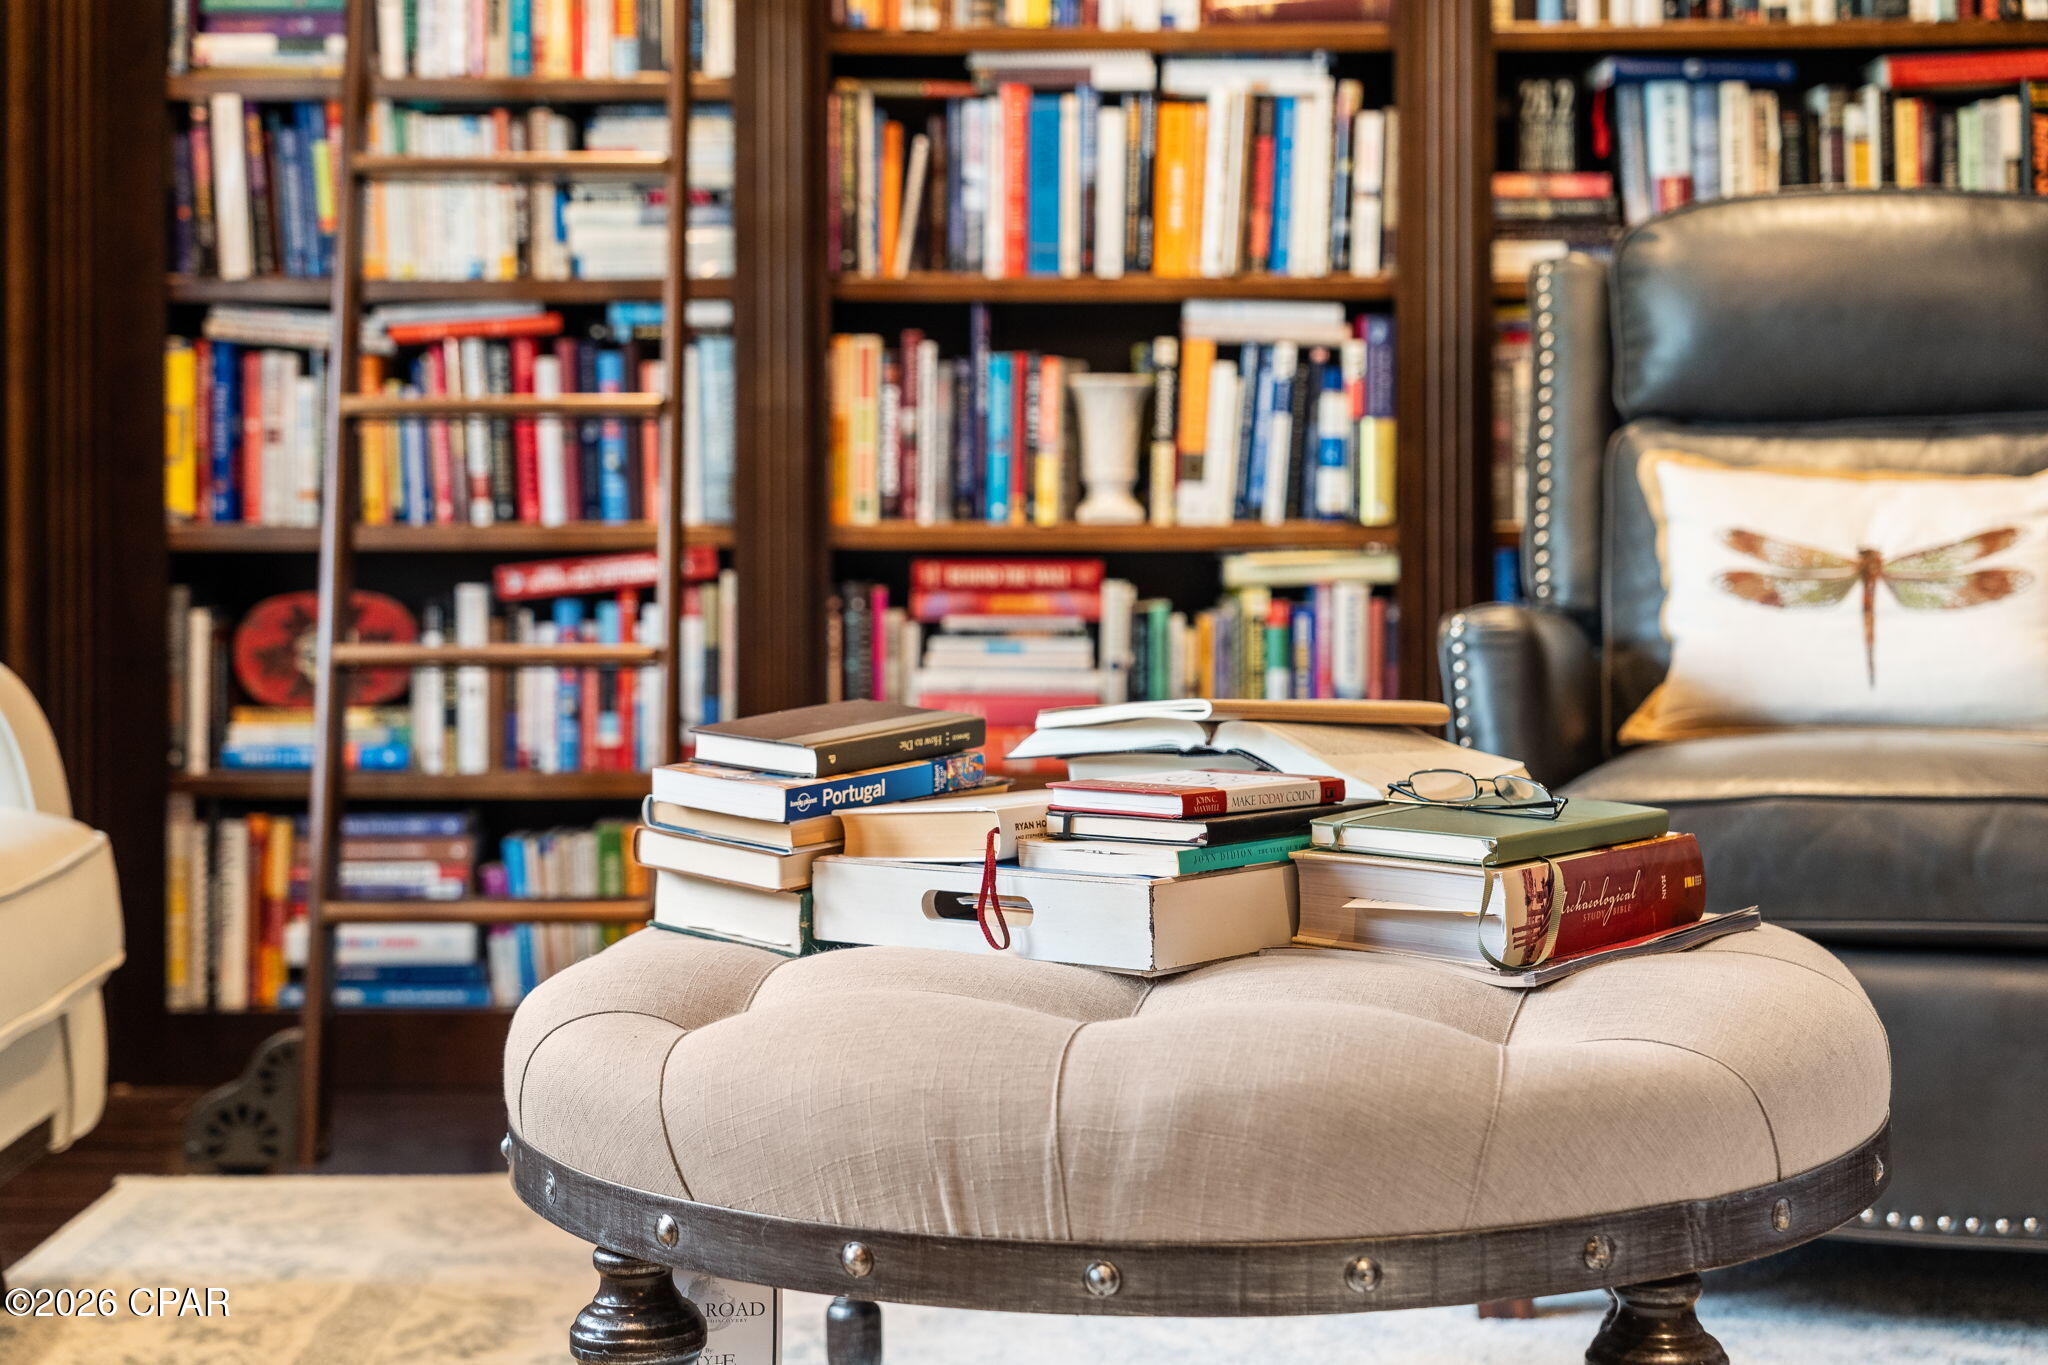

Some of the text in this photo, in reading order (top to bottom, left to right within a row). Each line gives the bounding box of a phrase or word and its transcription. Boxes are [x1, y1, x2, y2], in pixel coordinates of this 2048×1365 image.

[822, 778, 886, 807] Portugal
[1196, 795, 1211, 806] JOHN
[1231, 788, 1317, 808] MAKE TODAY COUNT
[1014, 820, 1035, 831] RYAN
[1193, 853, 1217, 865] JOAN
[1220, 848, 1253, 861] DIDION
[1583, 903, 1632, 922] STUDY BIBLE
[705, 1301, 766, 1318] ROAD
